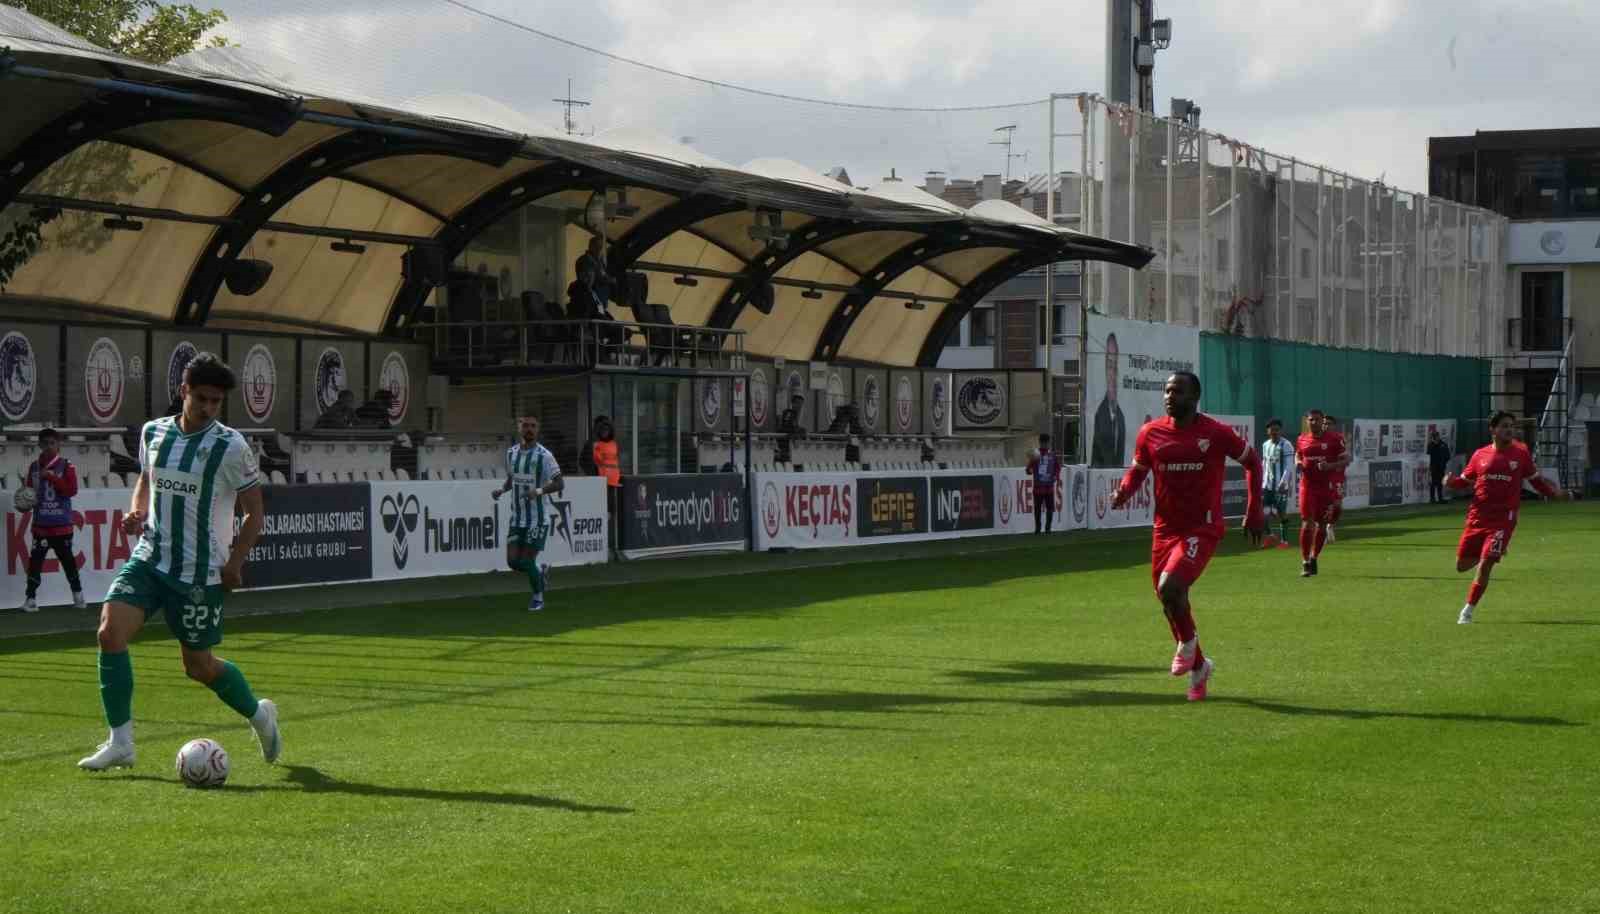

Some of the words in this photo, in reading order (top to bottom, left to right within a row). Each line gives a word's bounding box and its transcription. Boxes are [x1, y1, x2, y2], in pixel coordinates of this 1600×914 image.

[1167, 463, 1204, 472] METRO
[157, 478, 197, 494] SOCAR
[317, 506, 365, 532] HASTANESİ
[656, 489, 714, 532] trendyol
[785, 484, 851, 538] KEÇTAŞ
[424, 504, 499, 554] hummel
[573, 517, 602, 535] SPOR
[247, 544, 276, 562] BEYLİ
[279, 541, 313, 560] SAĞLIK
[316, 541, 346, 558] GRUBU
[182, 605, 209, 630] 22
